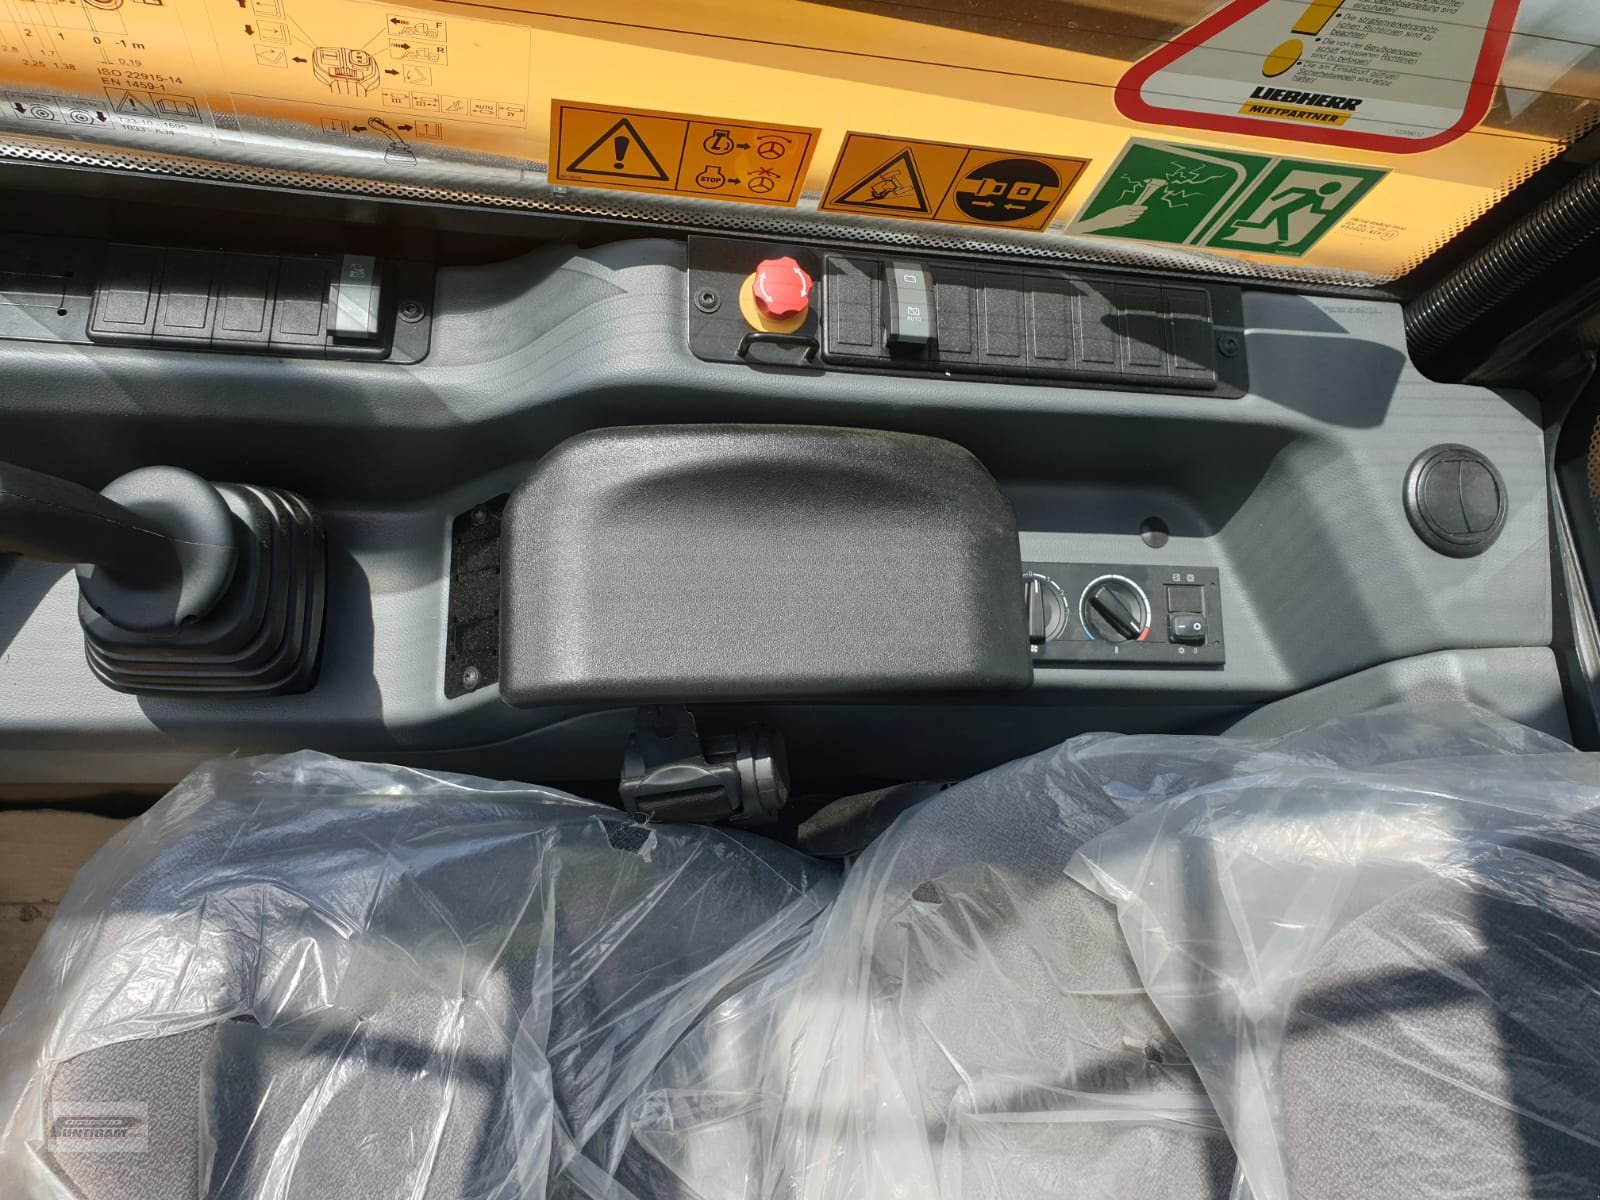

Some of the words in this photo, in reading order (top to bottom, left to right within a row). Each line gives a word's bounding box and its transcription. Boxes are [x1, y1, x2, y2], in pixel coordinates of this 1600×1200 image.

[23, 28, 33, 37] 2
[58, 32, 65, 40] 1
[93, 36, 102, 45] 0
[132, 41, 146, 50] m
[97, 67, 122, 77] ISO
[125, 70, 183, 84] 22915-14
[101, 77, 121, 86] EN
[125, 80, 166, 92] 1459-1
[1250, 86, 1363, 111] LIEBHERR
[1249, 105, 1339, 123] MIETPARTNER
